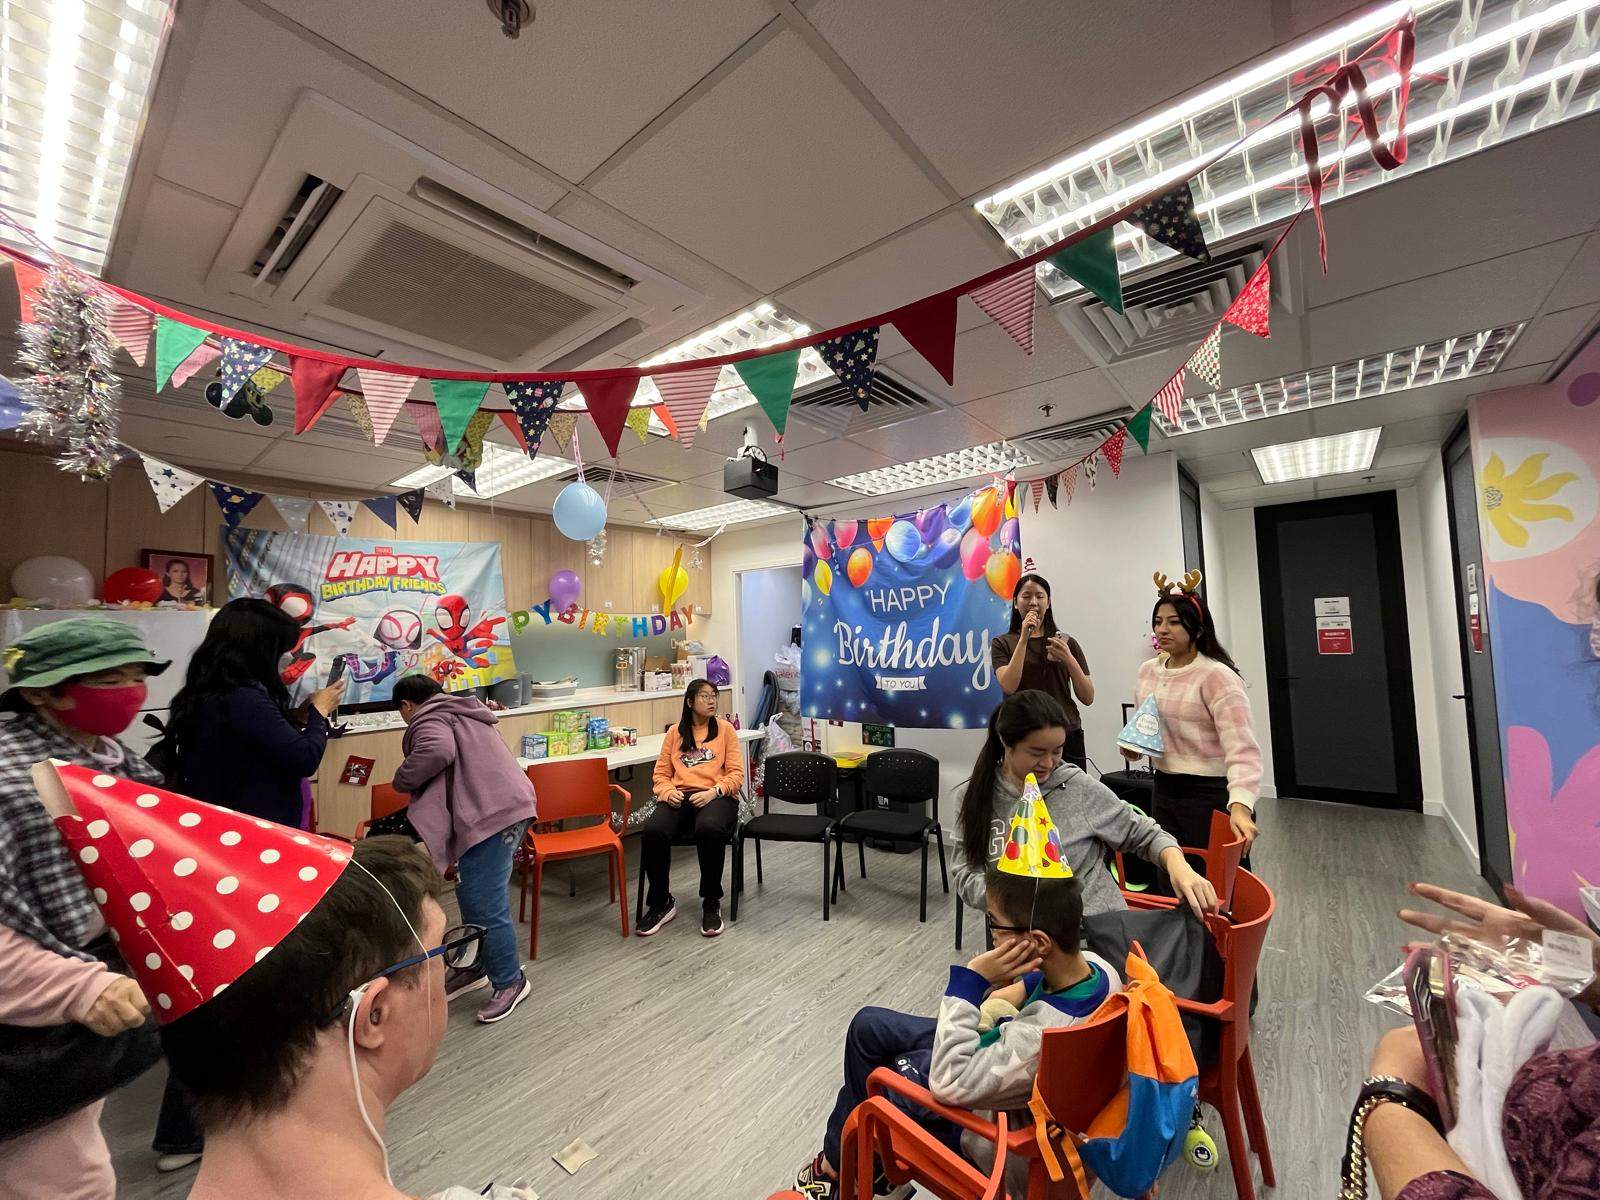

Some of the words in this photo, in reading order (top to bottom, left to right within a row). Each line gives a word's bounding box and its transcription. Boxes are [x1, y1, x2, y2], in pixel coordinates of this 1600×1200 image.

[327, 551, 440, 581] HAPPY
[321, 576, 389, 601] BIRTHDAY
[391, 577, 447, 595] FRIENDS
[870, 580, 951, 613] HAPPY
[557, 602, 694, 639] BIRTHDAY
[833, 616, 992, 691] Birthday
[884, 680, 896, 688] TO
[899, 680, 915, 689] YOU
